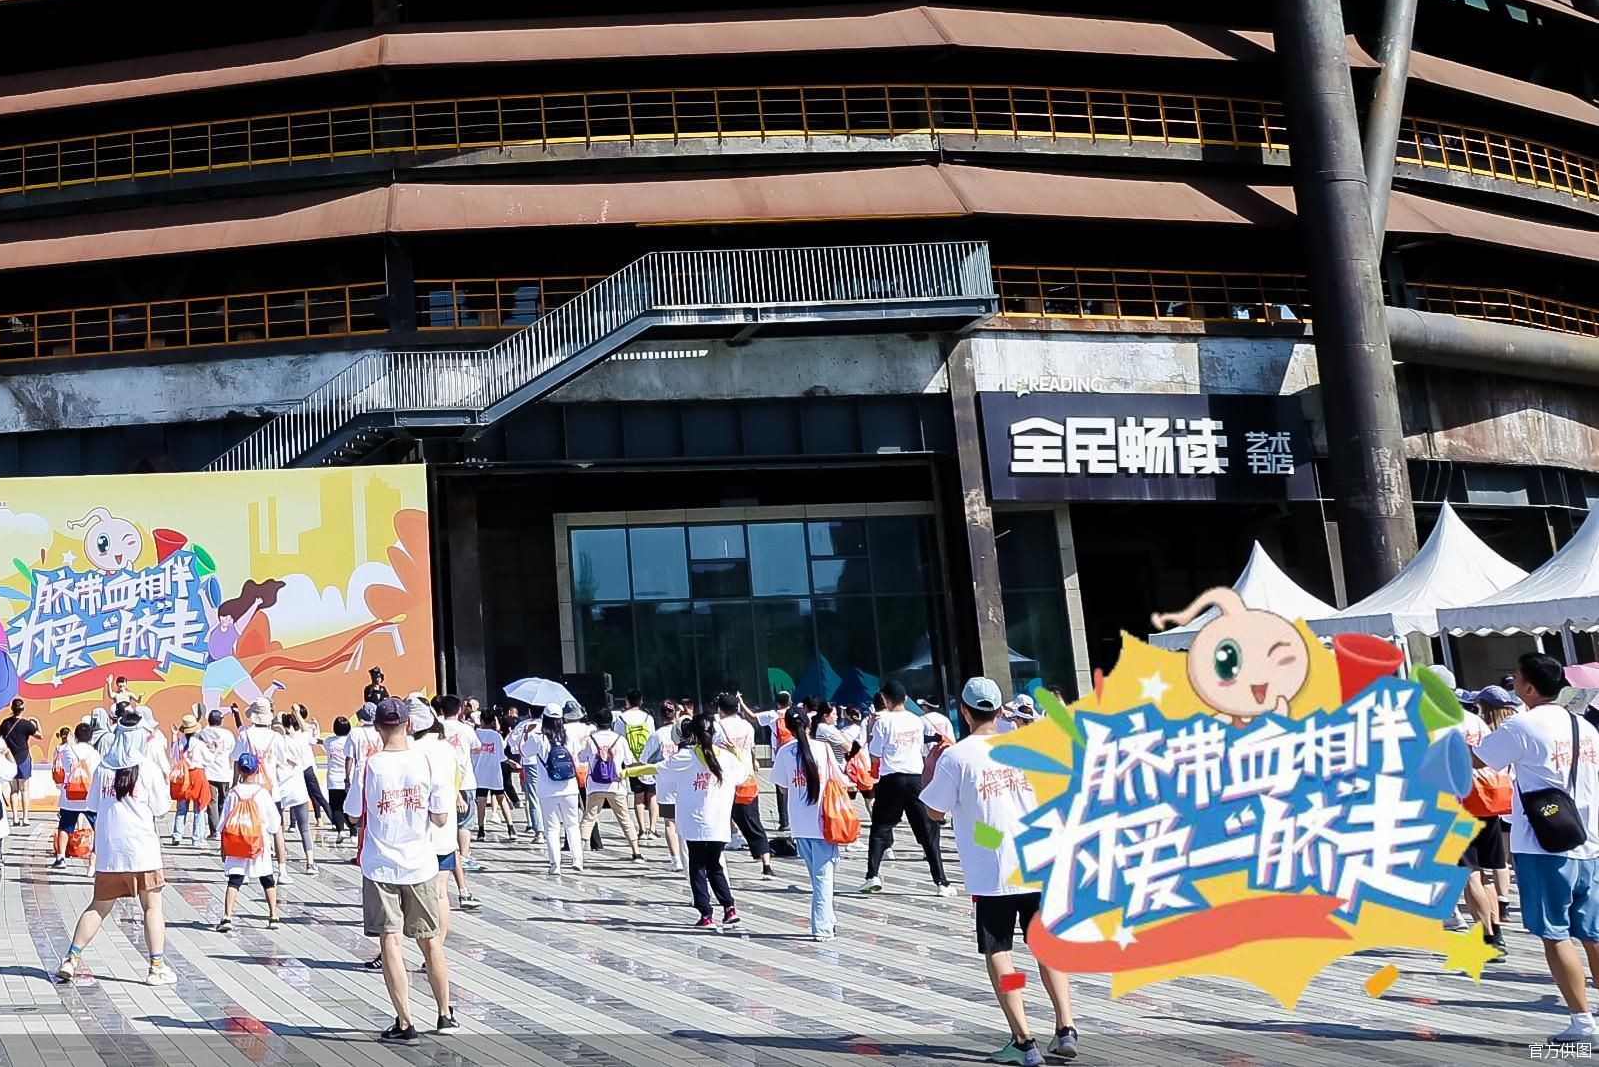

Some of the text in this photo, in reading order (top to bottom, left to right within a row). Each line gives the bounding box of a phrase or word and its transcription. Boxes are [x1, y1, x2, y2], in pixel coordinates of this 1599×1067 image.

[1010, 416, 1228, 475] 全民畅读
[1245, 431, 1291, 454] 艺术
[1247, 452, 1295, 475] 书店
[35, 555, 195, 617] 脐带血相伴
